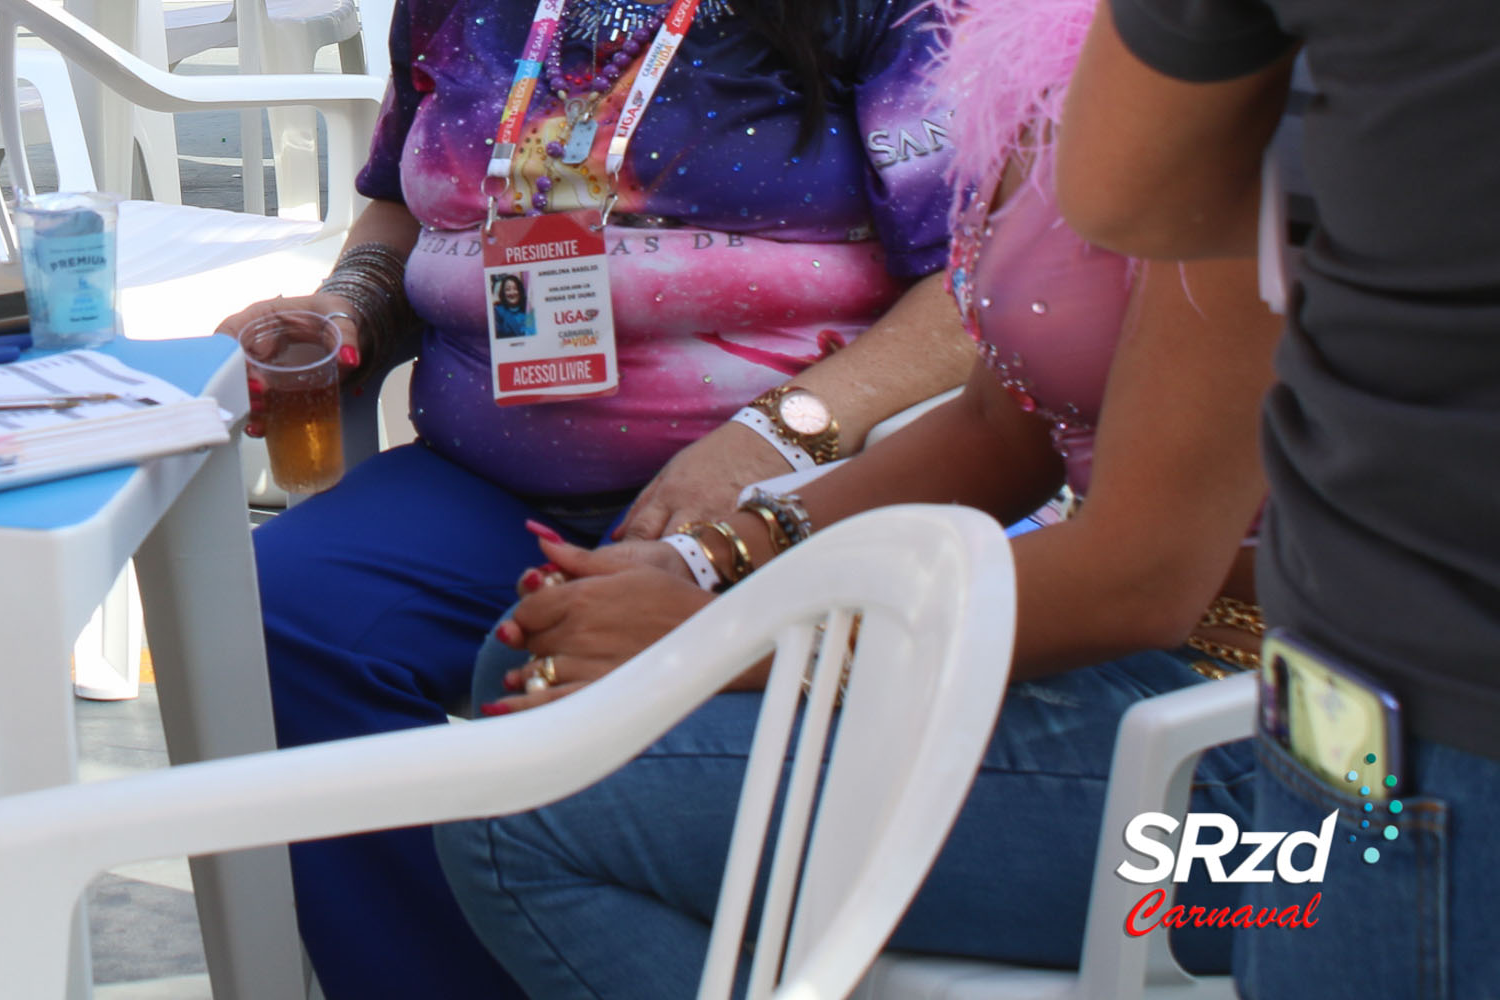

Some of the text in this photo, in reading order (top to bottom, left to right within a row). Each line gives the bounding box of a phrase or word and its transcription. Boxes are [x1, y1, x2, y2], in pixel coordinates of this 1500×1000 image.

[505, 239, 579, 263] PRESIDENTE
[572, 335, 598, 348] VIDA
[513, 360, 592, 386] ACESSO LIVRE
